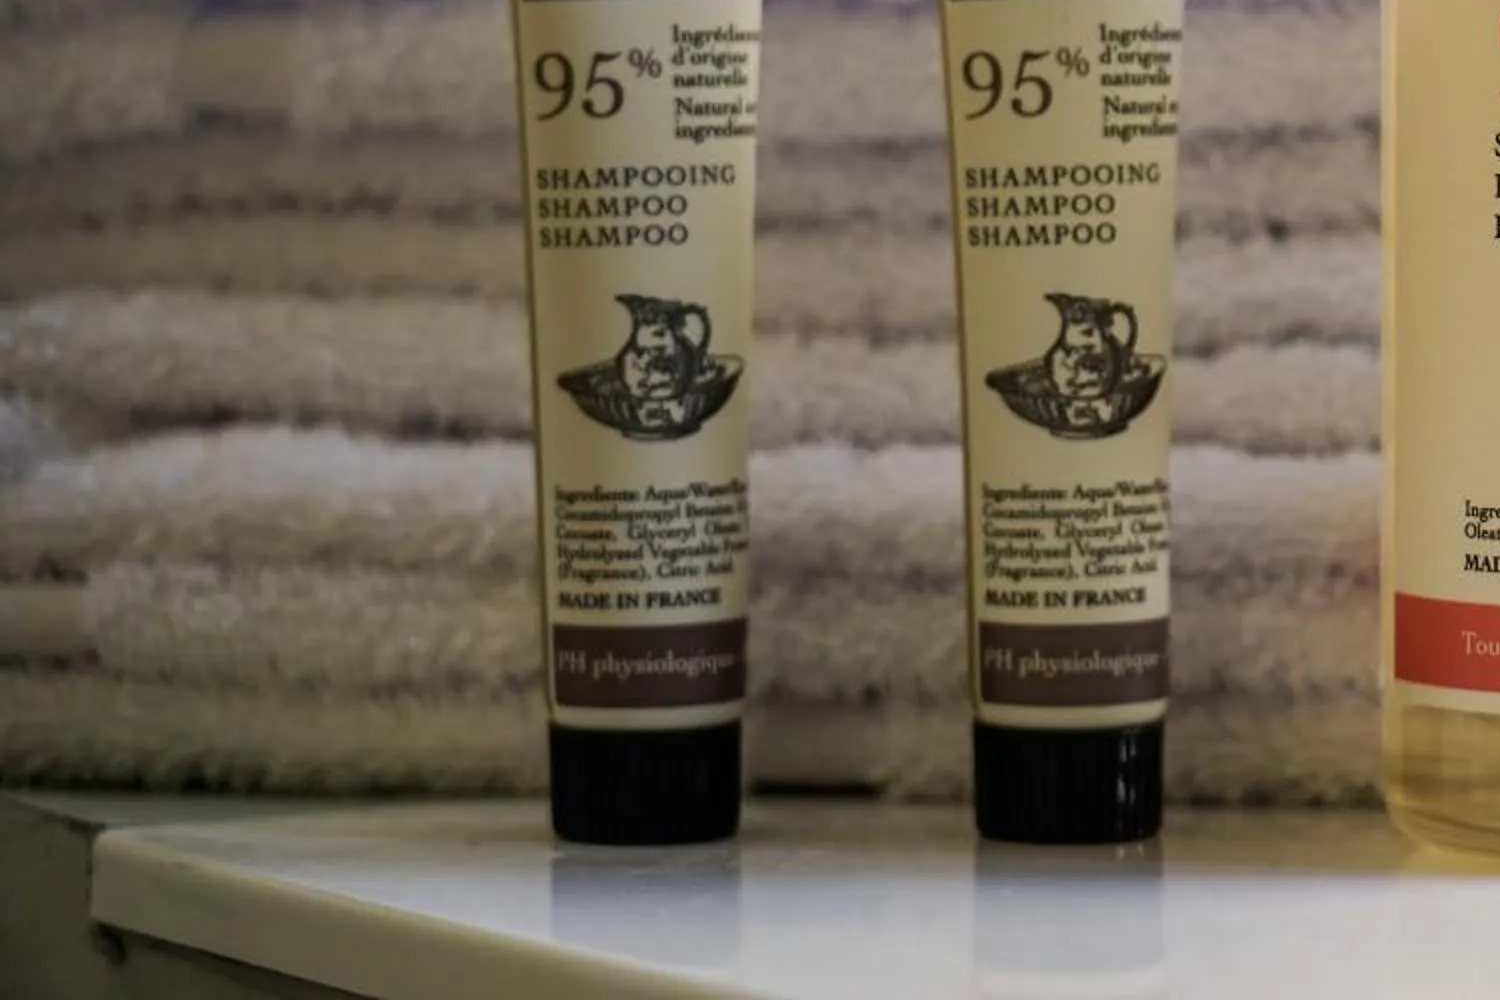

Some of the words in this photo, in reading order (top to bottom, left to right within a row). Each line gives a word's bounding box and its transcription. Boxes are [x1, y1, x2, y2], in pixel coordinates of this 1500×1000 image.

[537, 164, 736, 190] SHAMPOOING
[965, 163, 1160, 189] SHAMPOOING
[537, 195, 688, 219] SHAMPOO
[967, 194, 1116, 219] SHAMPOO
[539, 223, 689, 248] SHAMPOO
[968, 223, 1117, 248] SHAMPOO
[558, 591, 611, 611] MADE
[617, 591, 640, 610] IN
[645, 587, 721, 609] FRANCE
[985, 589, 1038, 609] MADE
[1044, 590, 1067, 609] IN
[1073, 587, 1147, 609] FRANCE
